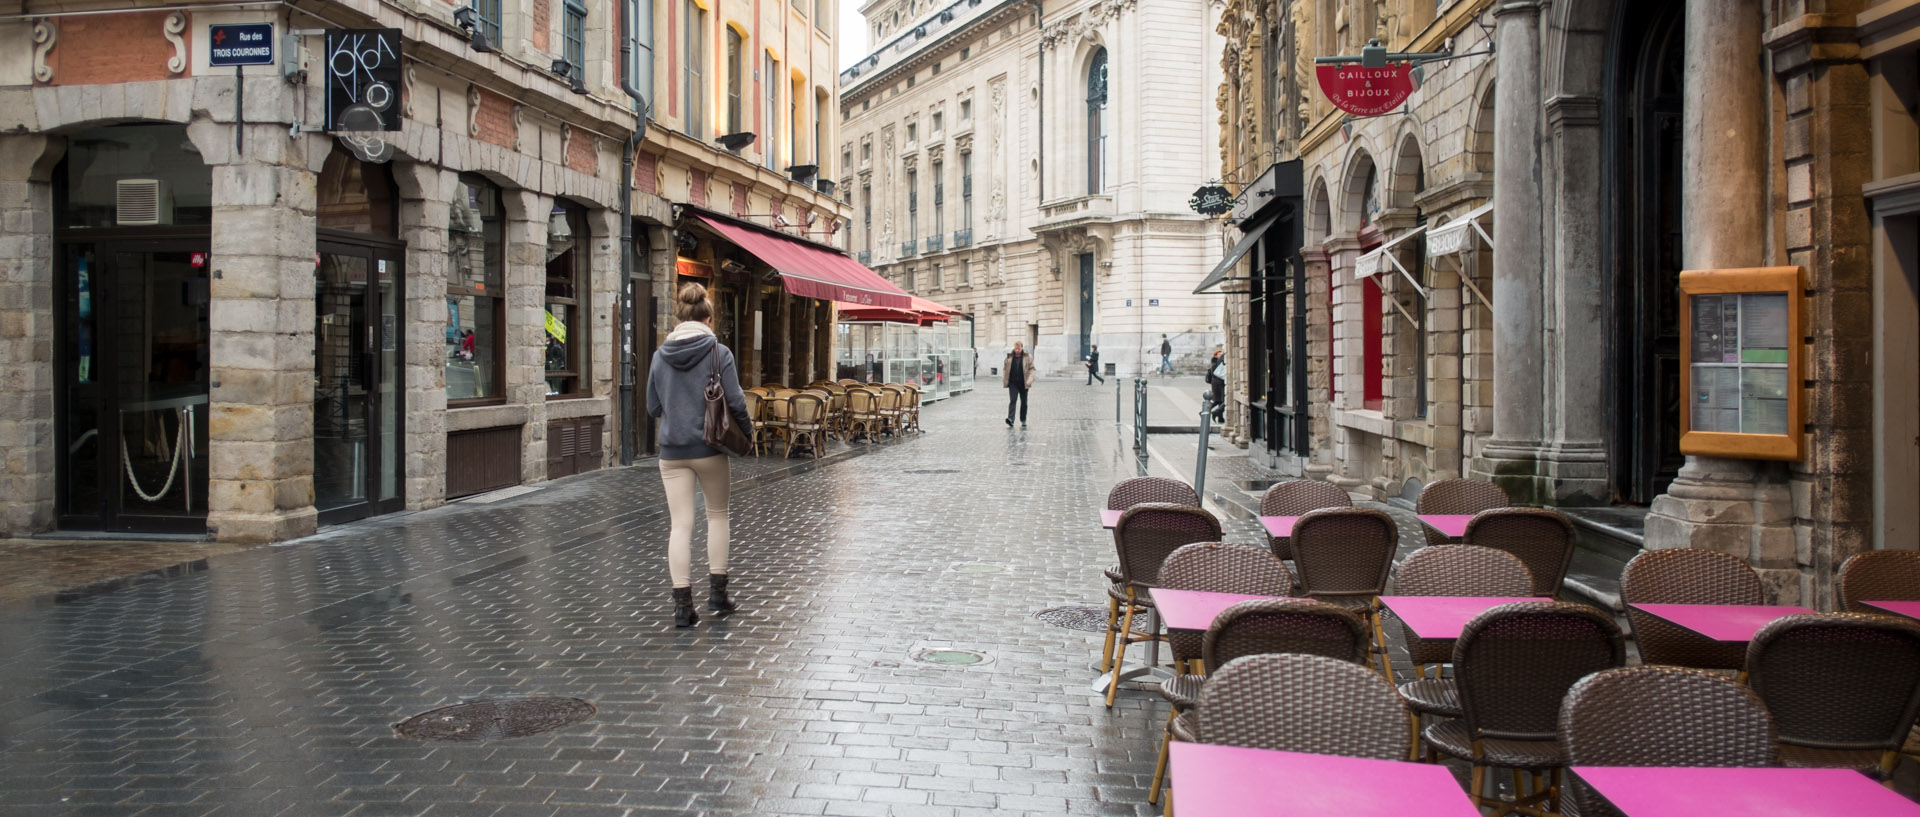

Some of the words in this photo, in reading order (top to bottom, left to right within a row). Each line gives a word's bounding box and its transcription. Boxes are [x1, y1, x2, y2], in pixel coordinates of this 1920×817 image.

[239, 32, 251, 41] Rue
[252, 32, 263, 41] des
[213, 48, 231, 57] TROIS
[232, 47, 270, 57] COURONNES
[1339, 70, 1398, 80] CAILLOUX
[1365, 80, 1372, 88] &
[1347, 88, 1390, 98] BIJOUX
[1333, 93, 1342, 103] De
[1341, 100, 1349, 109] la
[1349, 104, 1369, 114] Terre
[1369, 106, 1385, 114] aux
[1431, 231, 1462, 254] BIJOUX
[193, 254, 204, 265] illy
